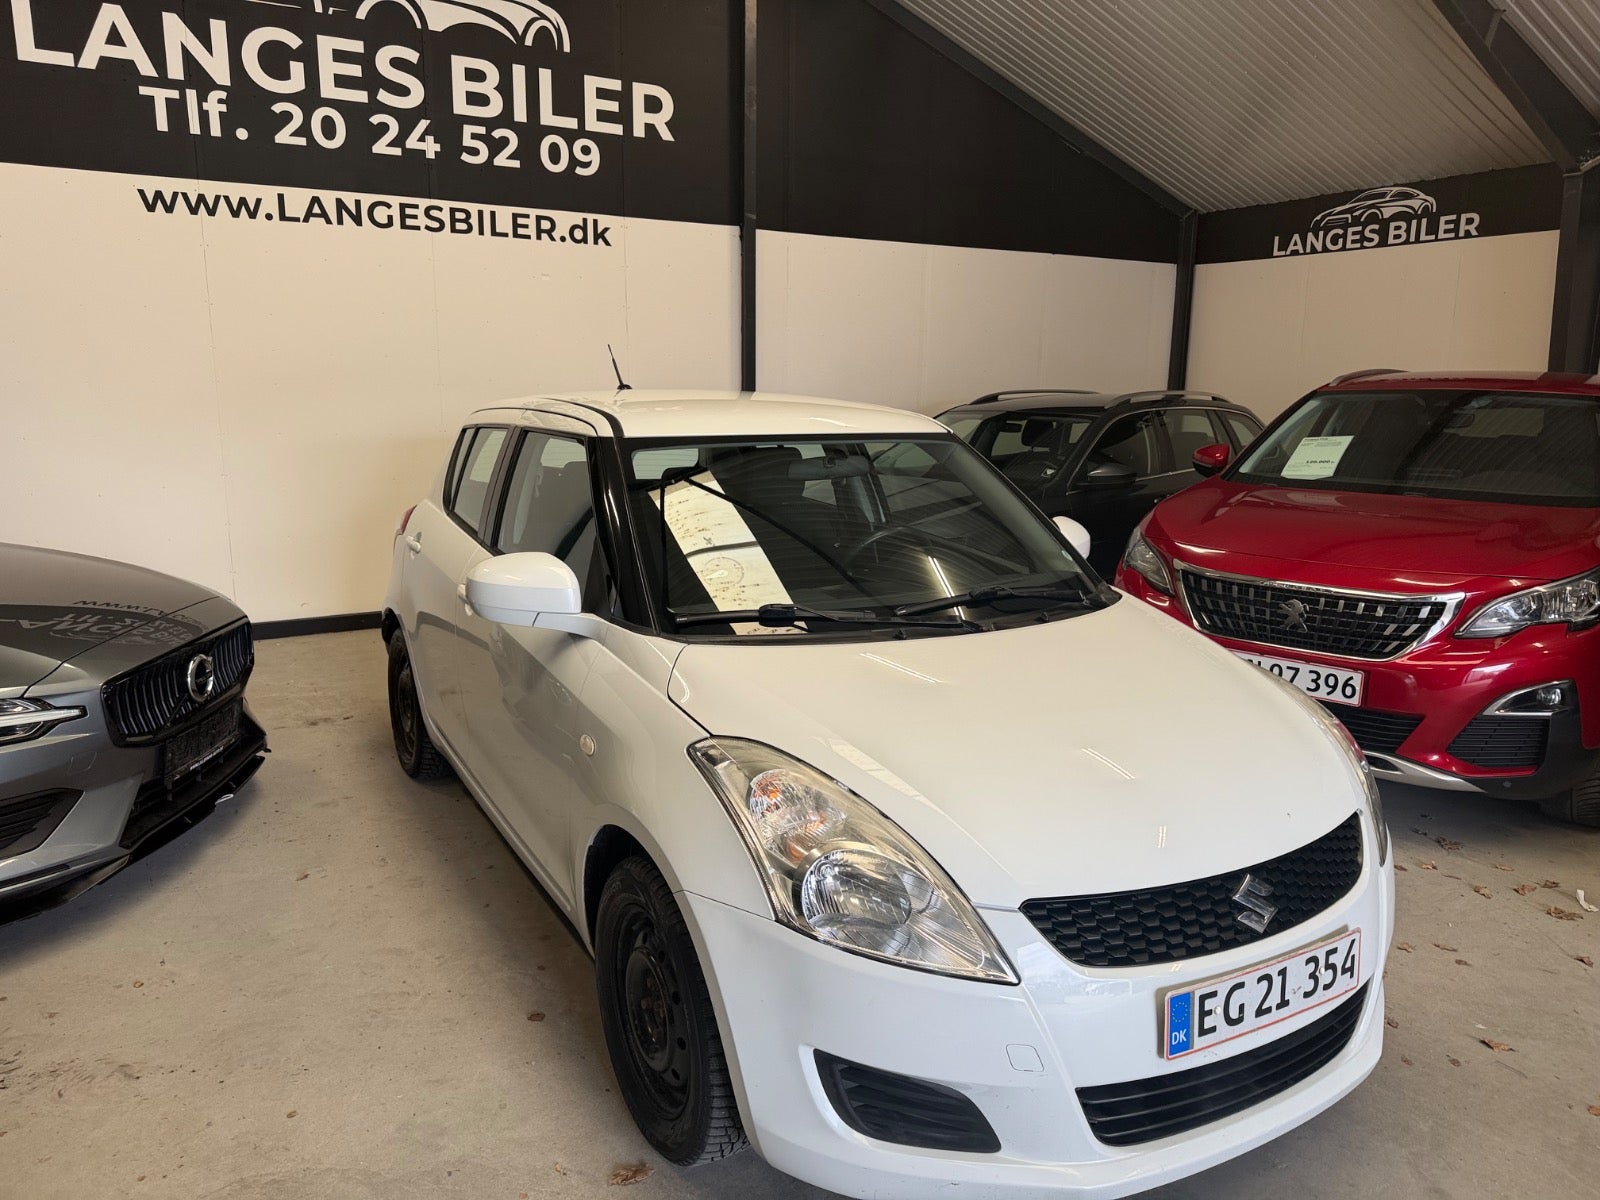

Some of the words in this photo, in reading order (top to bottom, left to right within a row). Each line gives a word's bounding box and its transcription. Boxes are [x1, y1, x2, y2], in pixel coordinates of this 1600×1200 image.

[11, 0, 425, 109] LANGES
[450, 54, 675, 142] BILER
[138, 86, 249, 141] Tlf.
[270, 102, 347, 149] 20
[368, 113, 441, 160] 24
[460, 124, 521, 168] 52
[539, 134, 601, 176] 09
[136, 188, 612, 247] www.LANGESBILER.dk
[1272, 224, 1380, 256] LANGES
[1387, 212, 1481, 245] BILER
[1306, 670, 1357, 699] 396
[1198, 981, 1246, 1037] EG
[1255, 966, 1290, 1018] 21
[1303, 938, 1356, 998] 354
[1171, 1029, 1187, 1045] DK
